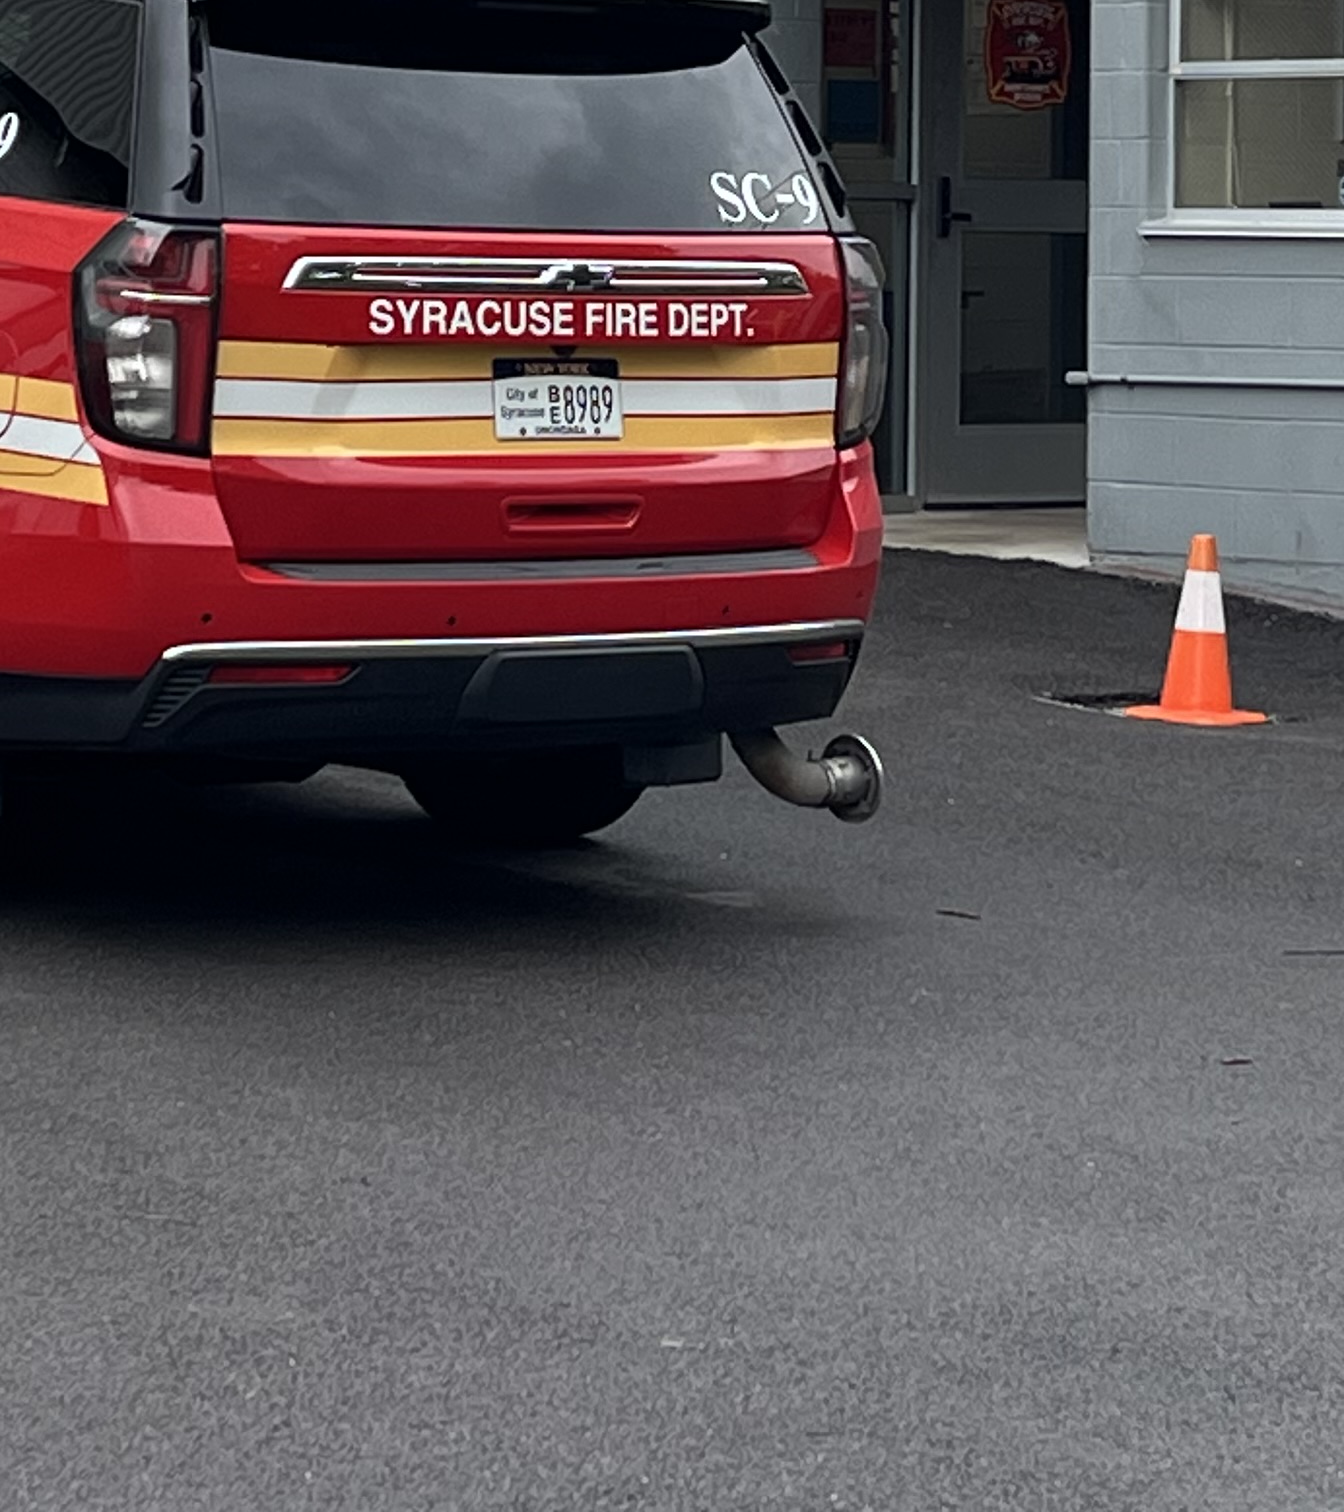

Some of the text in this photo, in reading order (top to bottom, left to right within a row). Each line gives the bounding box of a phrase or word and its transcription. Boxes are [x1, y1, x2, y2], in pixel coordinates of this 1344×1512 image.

[710, 172, 818, 224] SC-9
[369, 299, 754, 337] SYRACUSE FIRE DEPT.
